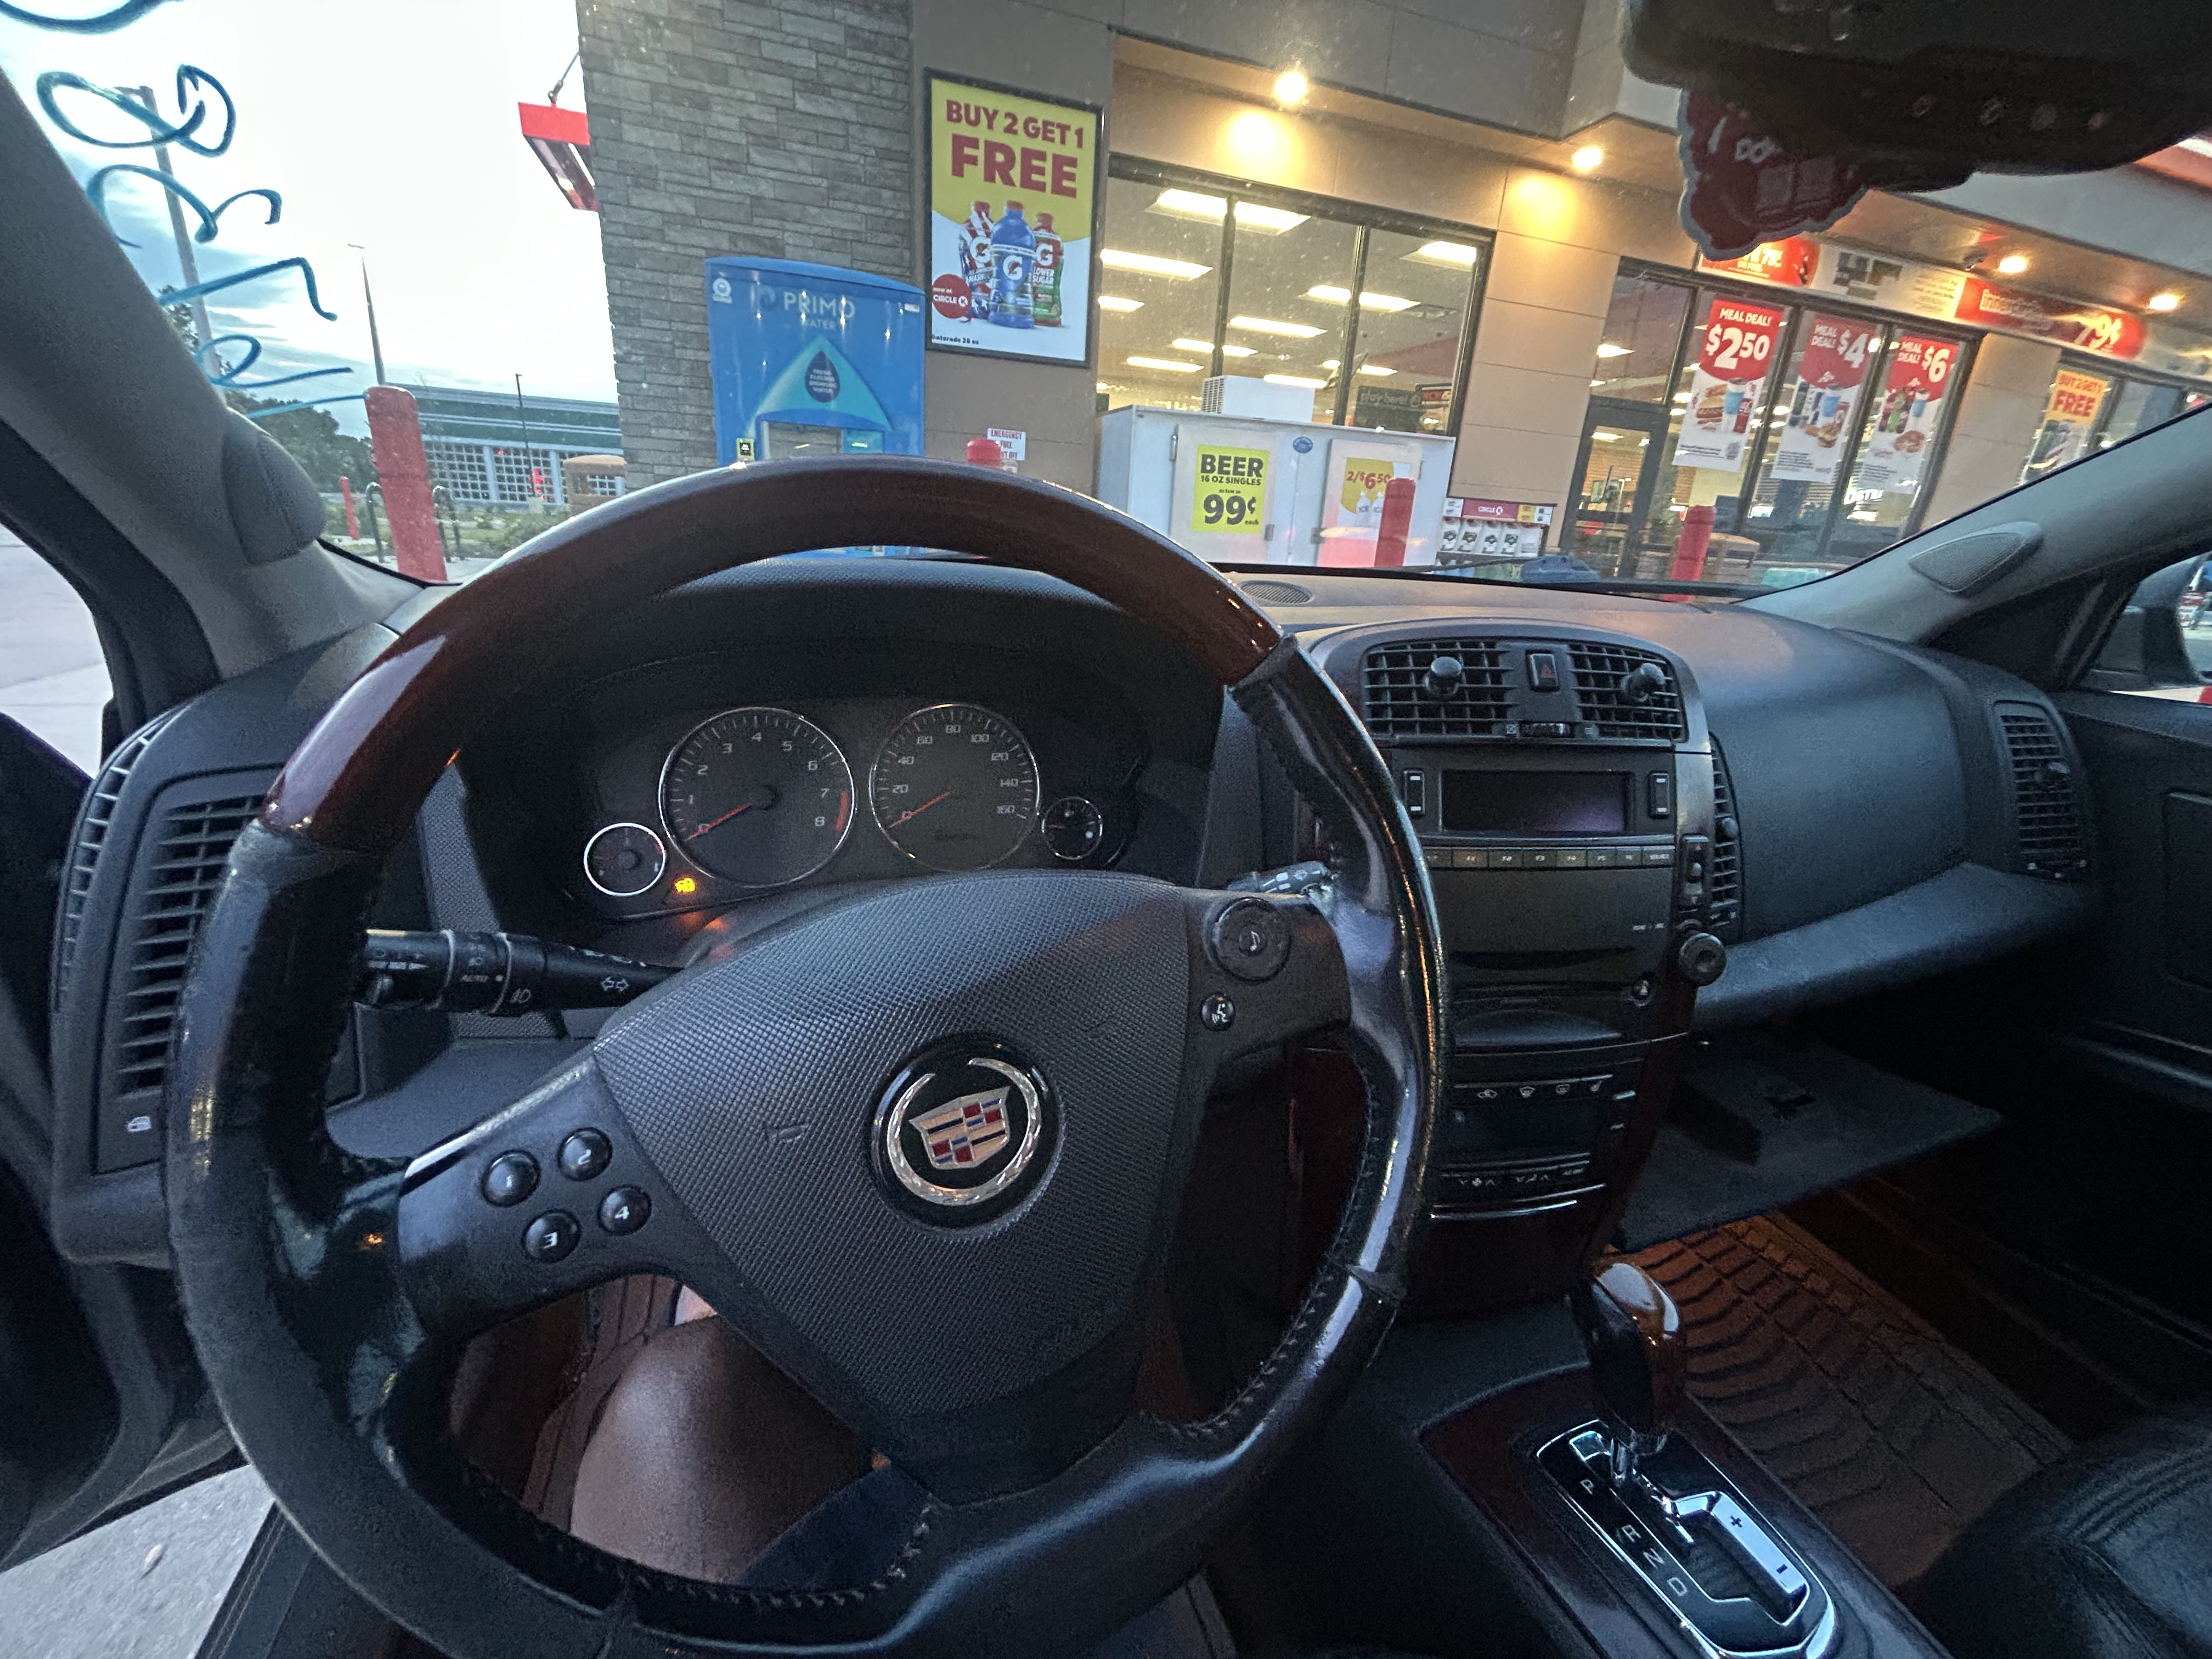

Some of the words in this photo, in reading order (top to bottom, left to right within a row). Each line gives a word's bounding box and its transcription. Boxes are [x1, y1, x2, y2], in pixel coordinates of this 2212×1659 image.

[946, 99, 998, 130] BUY
[1003, 112, 1018, 136] 2
[1023, 117, 1071, 145] GET
[1074, 127, 1084, 149] 1
[951, 133, 1078, 199] FREE
[1032, 275, 1054, 285] SUGAR
[783, 291, 855, 319] PRIMO
[933, 295, 957, 303] CIRCLE
[958, 296, 968, 307] K
[1719, 308, 1745, 323] MEAL
[1745, 313, 1772, 326] DEAL!
[1814, 325, 1837, 337] MEAL
[1811, 335, 1836, 348] DEAL!
[1900, 341, 1922, 354] MEAL
[1837, 330, 1869, 368] $4
[1898, 352, 1921, 364] DEAL!
[1922, 346, 1950, 382] $6
[2053, 390, 2096, 417] FREE
[1201, 454, 1263, 478] BEER
[1226, 476, 1261, 486] SINGLES
[1203, 494, 1256, 525] 99¢
[1358, 505, 1370, 513] ICE
[752, 732, 762, 741] 4
[723, 743, 732, 754] 3
[782, 741, 792, 752] 5
[697, 765, 708, 775] 2
[821, 788, 828, 798] 7
[892, 785, 908, 794] 20
[578, 1149, 591, 1165] 2
[506, 1176, 513, 1187] 1
[615, 1206, 629, 1220] 4
[544, 1232, 557, 1248] 3
[1581, 1479, 1594, 1494] P
[1621, 1525, 1642, 1543] R
[1643, 1548, 1665, 1568] N
[1667, 1576, 1688, 1596] D
